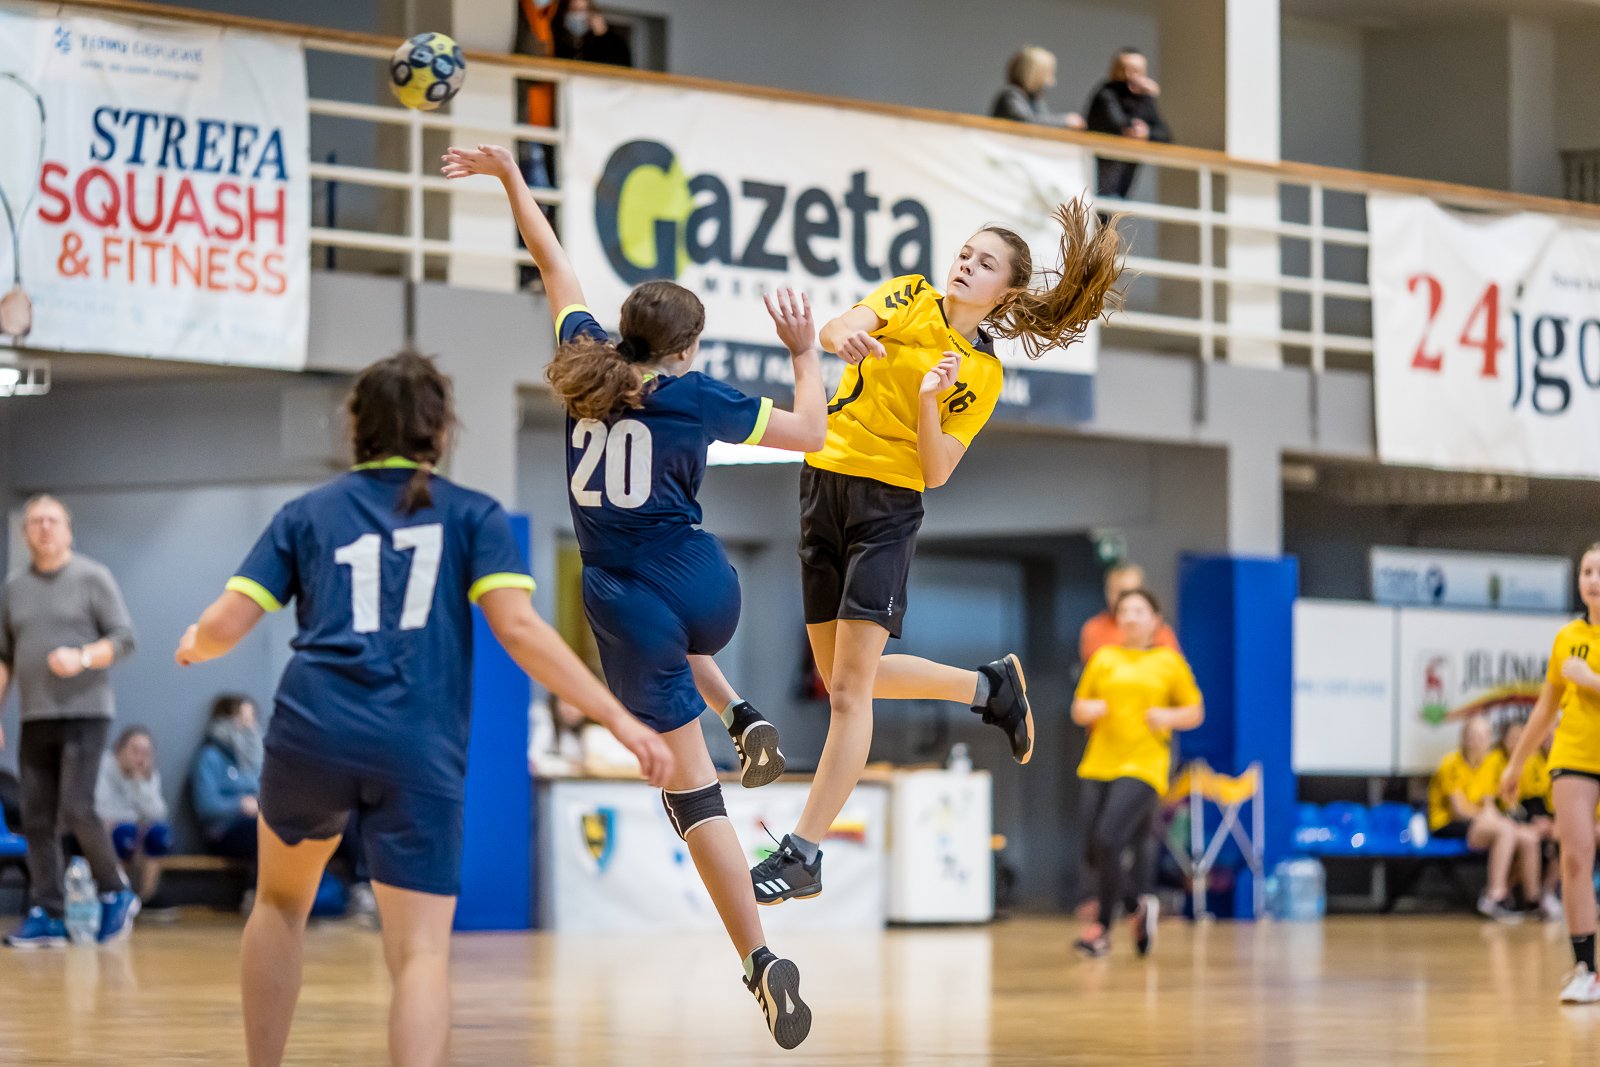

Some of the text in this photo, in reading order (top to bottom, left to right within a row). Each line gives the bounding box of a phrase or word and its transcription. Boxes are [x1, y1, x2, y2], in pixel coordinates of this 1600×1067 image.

[90, 105, 289, 181] STREFA
[38, 161, 287, 246] SQUASH
[596, 139, 934, 286] Gazeta
[57, 231, 288, 296] & FITNESS
[943, 381, 977, 413] 16
[570, 417, 652, 509] 20
[334, 523, 444, 633] 17
